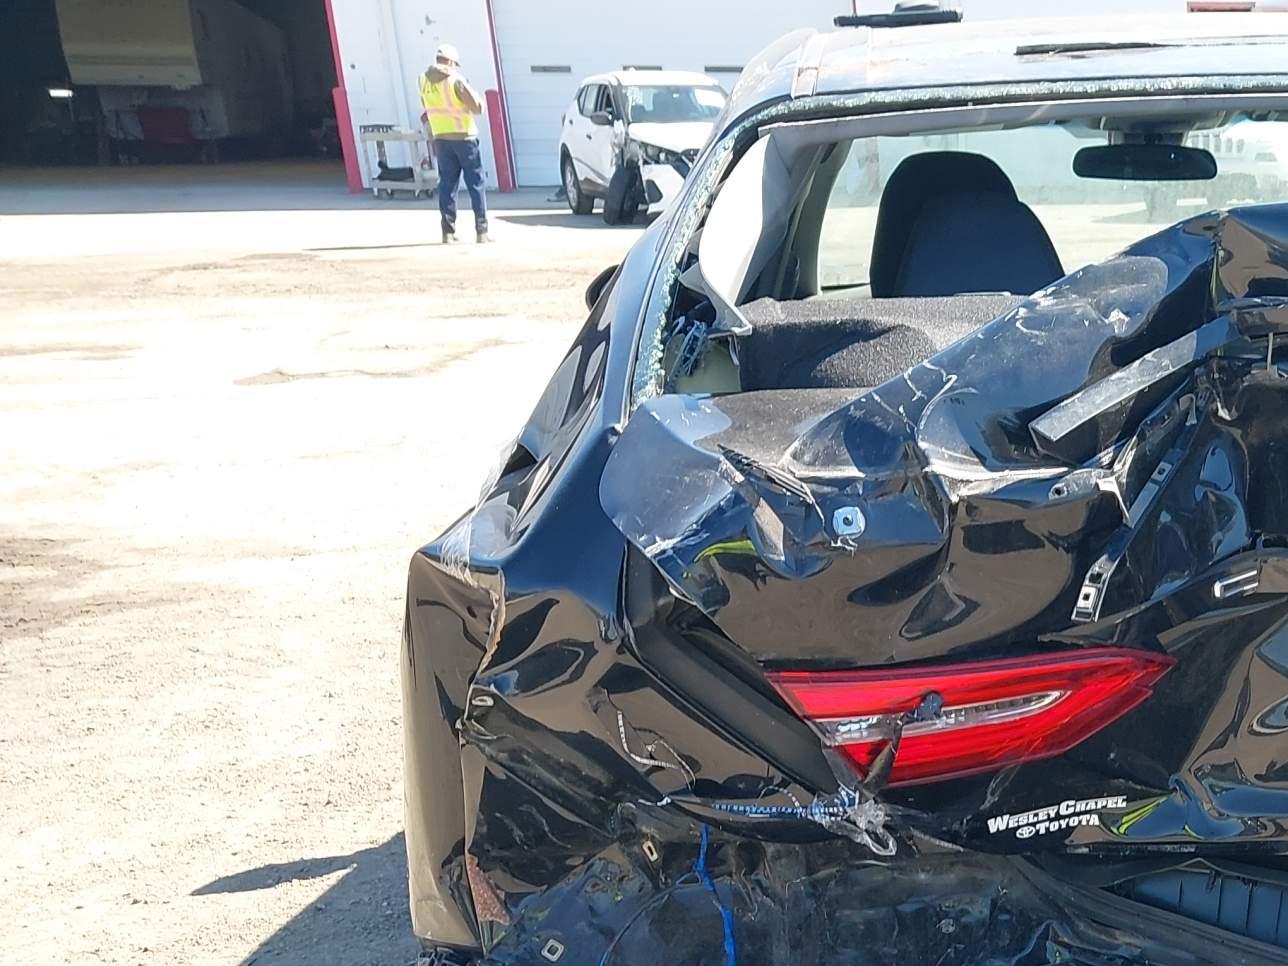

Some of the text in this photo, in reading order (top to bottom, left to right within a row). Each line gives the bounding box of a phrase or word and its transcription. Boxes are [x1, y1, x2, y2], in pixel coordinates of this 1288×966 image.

[987, 795, 1127, 833] WESLEY CHAPEL
[1036, 814, 1099, 834] TOYOTA
